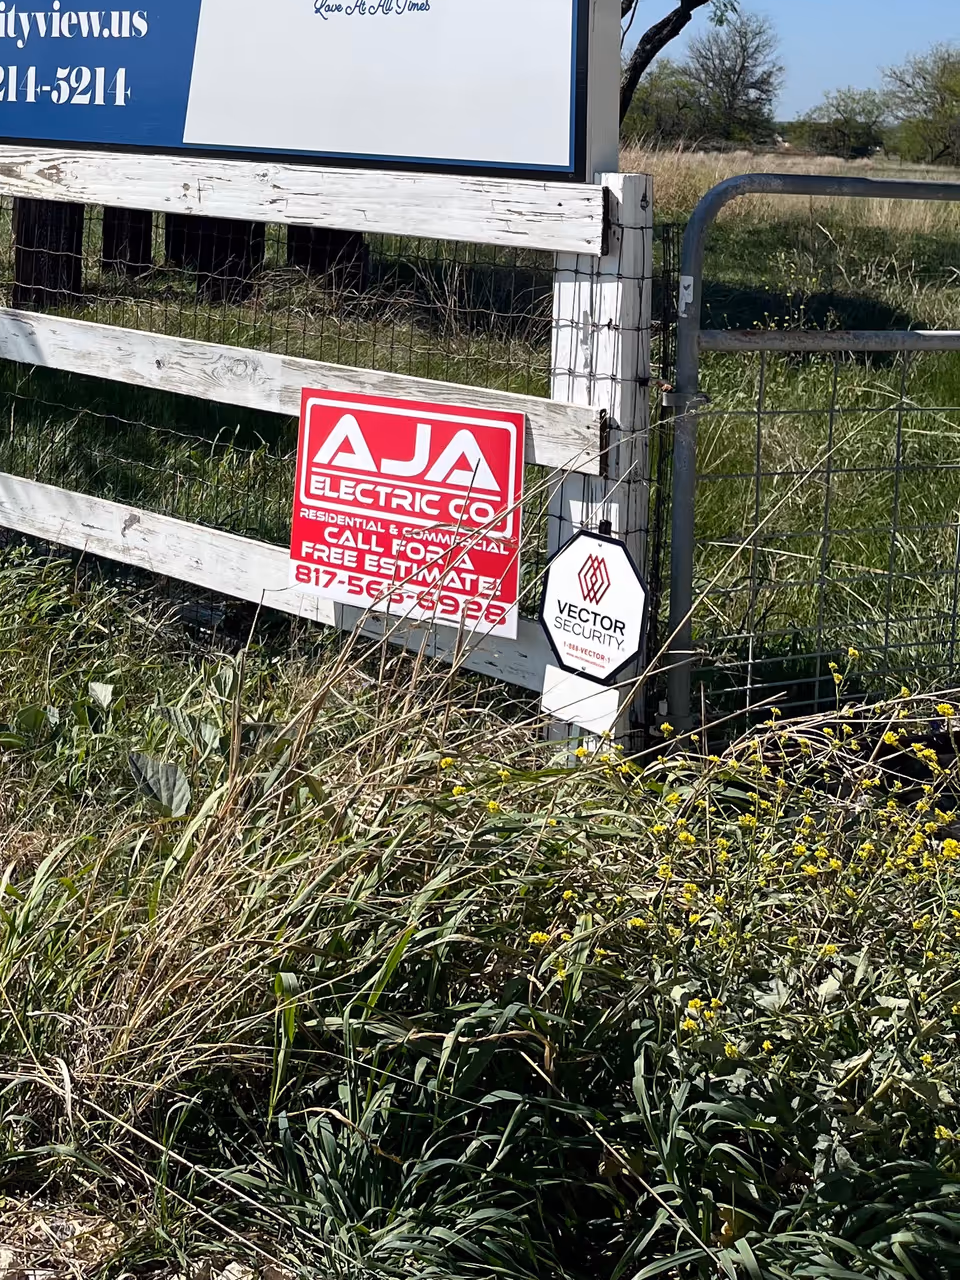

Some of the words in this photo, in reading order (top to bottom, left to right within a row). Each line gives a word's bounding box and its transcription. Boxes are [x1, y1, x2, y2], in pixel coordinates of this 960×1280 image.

[311, 413, 501, 491] AJA
[310, 475, 442, 516] ELECTRIC
[299, 508, 385, 533] RESIDENTIAL
[389, 524, 399, 535] &
[301, 542, 359, 568] FREE
[323, 527, 385, 553] CALL
[392, 539, 445, 565] FOR
[453, 553, 475, 570] A
[554, 616, 624, 650] SECURITY
[557, 599, 626, 636] VECTOR
